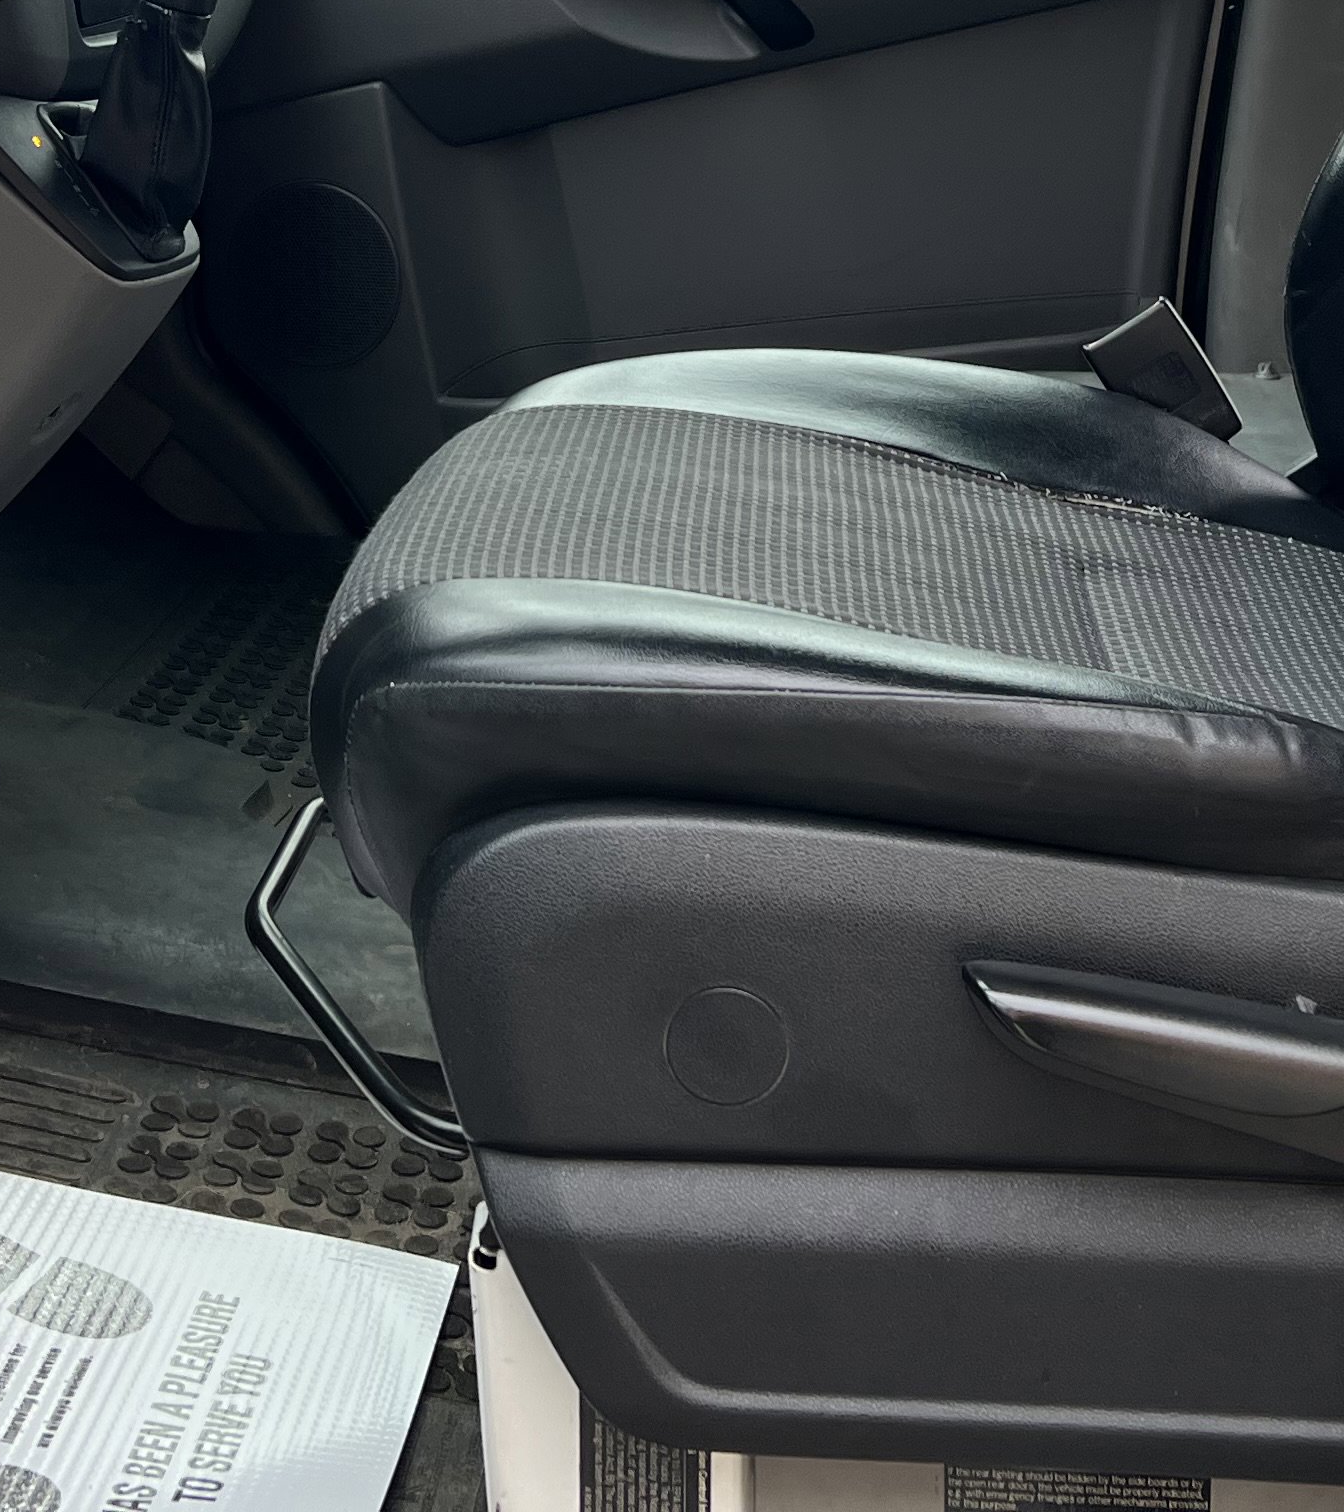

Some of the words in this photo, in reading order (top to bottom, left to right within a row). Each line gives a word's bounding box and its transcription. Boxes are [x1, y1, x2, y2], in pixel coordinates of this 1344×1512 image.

[8, 1343, 28, 1357] for
[157, 1289, 241, 1399] PLEASURE
[26, 1380, 45, 1396] our
[36, 1347, 62, 1379] service
[215, 1352, 274, 1397] YOU
[43, 1398, 72, 1431] always
[150, 1402, 194, 1421] A
[37, 1432, 55, 1448] are
[121, 1419, 186, 1480] BEEN
[188, 1399, 255, 1473] SERVE
[171, 1476, 224, 1503] TO
[948, 1477, 962, 1487] the
[987, 1481, 1005, 1489] rear
[1037, 1481, 1053, 1492] the
[1054, 1483, 1085, 1494] vehicle
[1086, 1484, 1108, 1495] must
[1109, 1486, 1122, 1496] be
[1123, 1487, 1160, 1499] properly
[972, 1469, 989, 1478] rear
[992, 1469, 1023, 1482] lighting
[1025, 1471, 1053, 1481] should
[1054, 1472, 1066, 1482] be
[1067, 1472, 1097, 1484] hidden
[1098, 1474, 1109, 1486] by
[1111, 1475, 1126, 1485] the
[1128, 1476, 1146, 1486] side
[1147, 1477, 1179, 1487] boards
[1180, 1479, 1189, 1488] or
[1191, 1478, 1204, 1489] by
[965, 1489, 985, 1498] with
[986, 1491, 1035, 1503] emergency
[1037, 1492, 1075, 1505] triangles
[1076, 1496, 1085, 1504] or
[1088, 1495, 1112, 1505] other
[1113, 1497, 1167, 1508] mechanisms
[1168, 1499, 1208, 1510] provided
